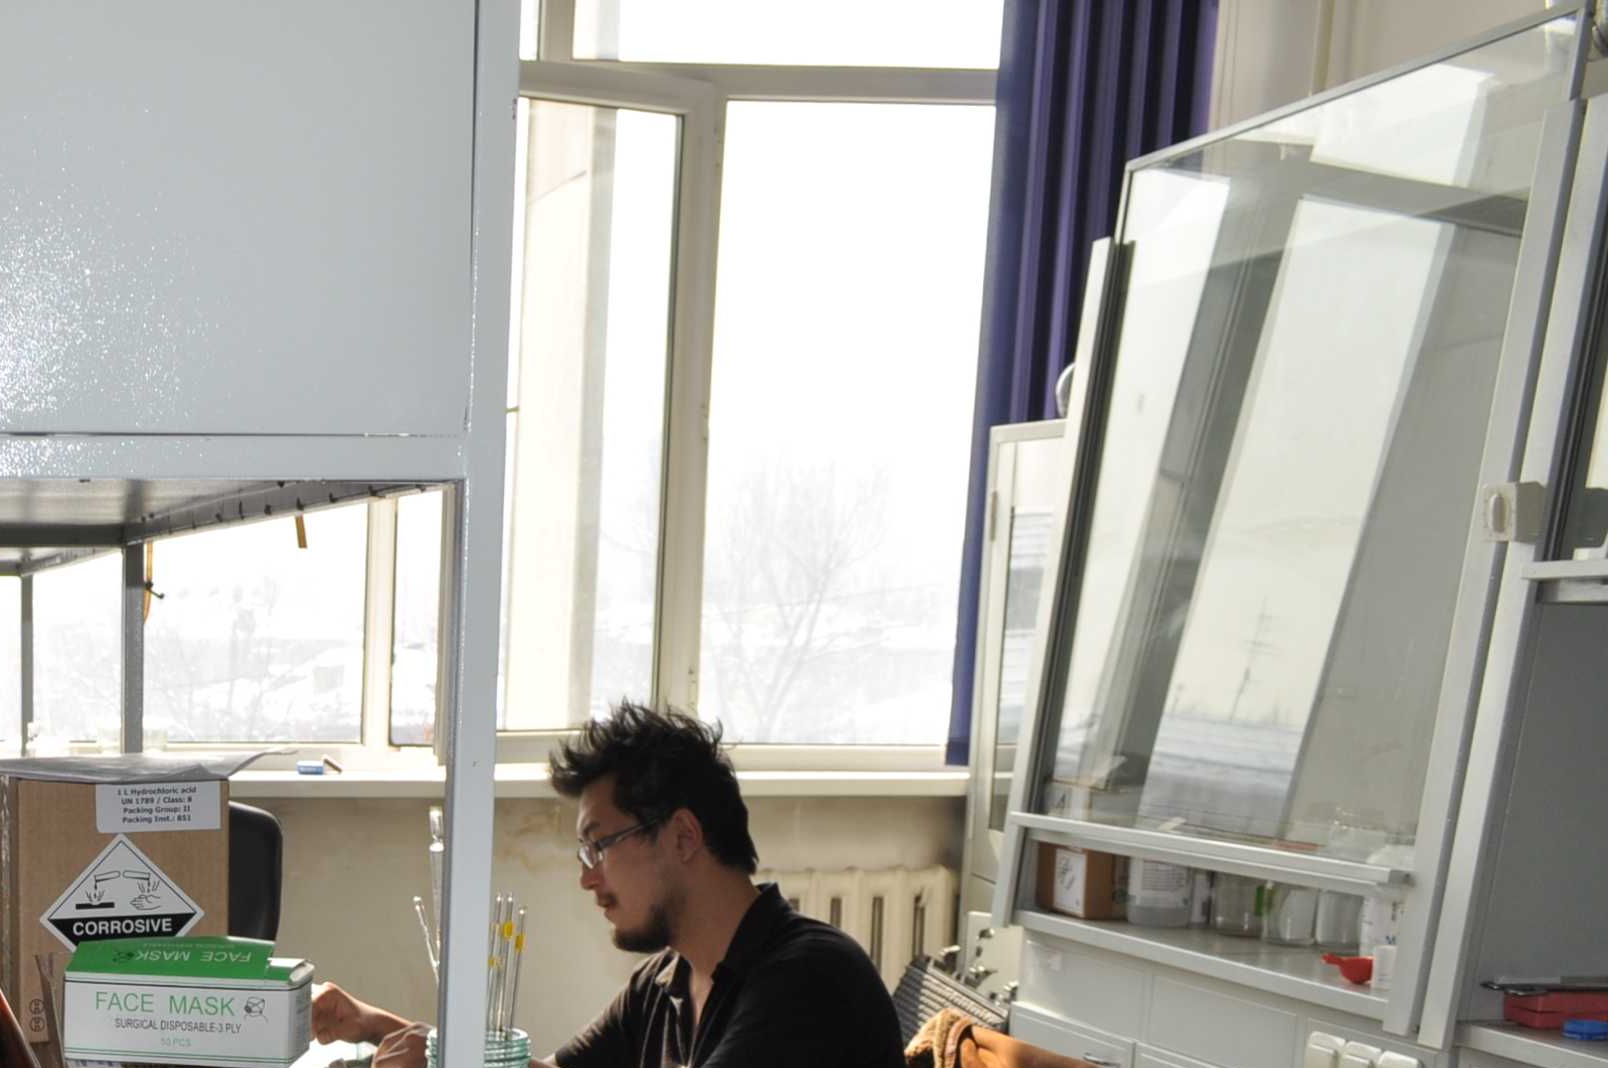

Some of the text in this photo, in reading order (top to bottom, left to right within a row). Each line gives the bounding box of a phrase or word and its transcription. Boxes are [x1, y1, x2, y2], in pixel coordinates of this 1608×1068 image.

[130, 786, 179, 796] Hydrochloric
[181, 786, 197, 794] acid
[155, 805, 181, 813] Group:
[72, 918, 172, 936] CORROSIVE
[135, 950, 251, 963] FACE MASK
[95, 991, 235, 1017] FACE MASK
[115, 1018, 158, 1031] SURGICAL
[225, 1023, 242, 1034] PLY
